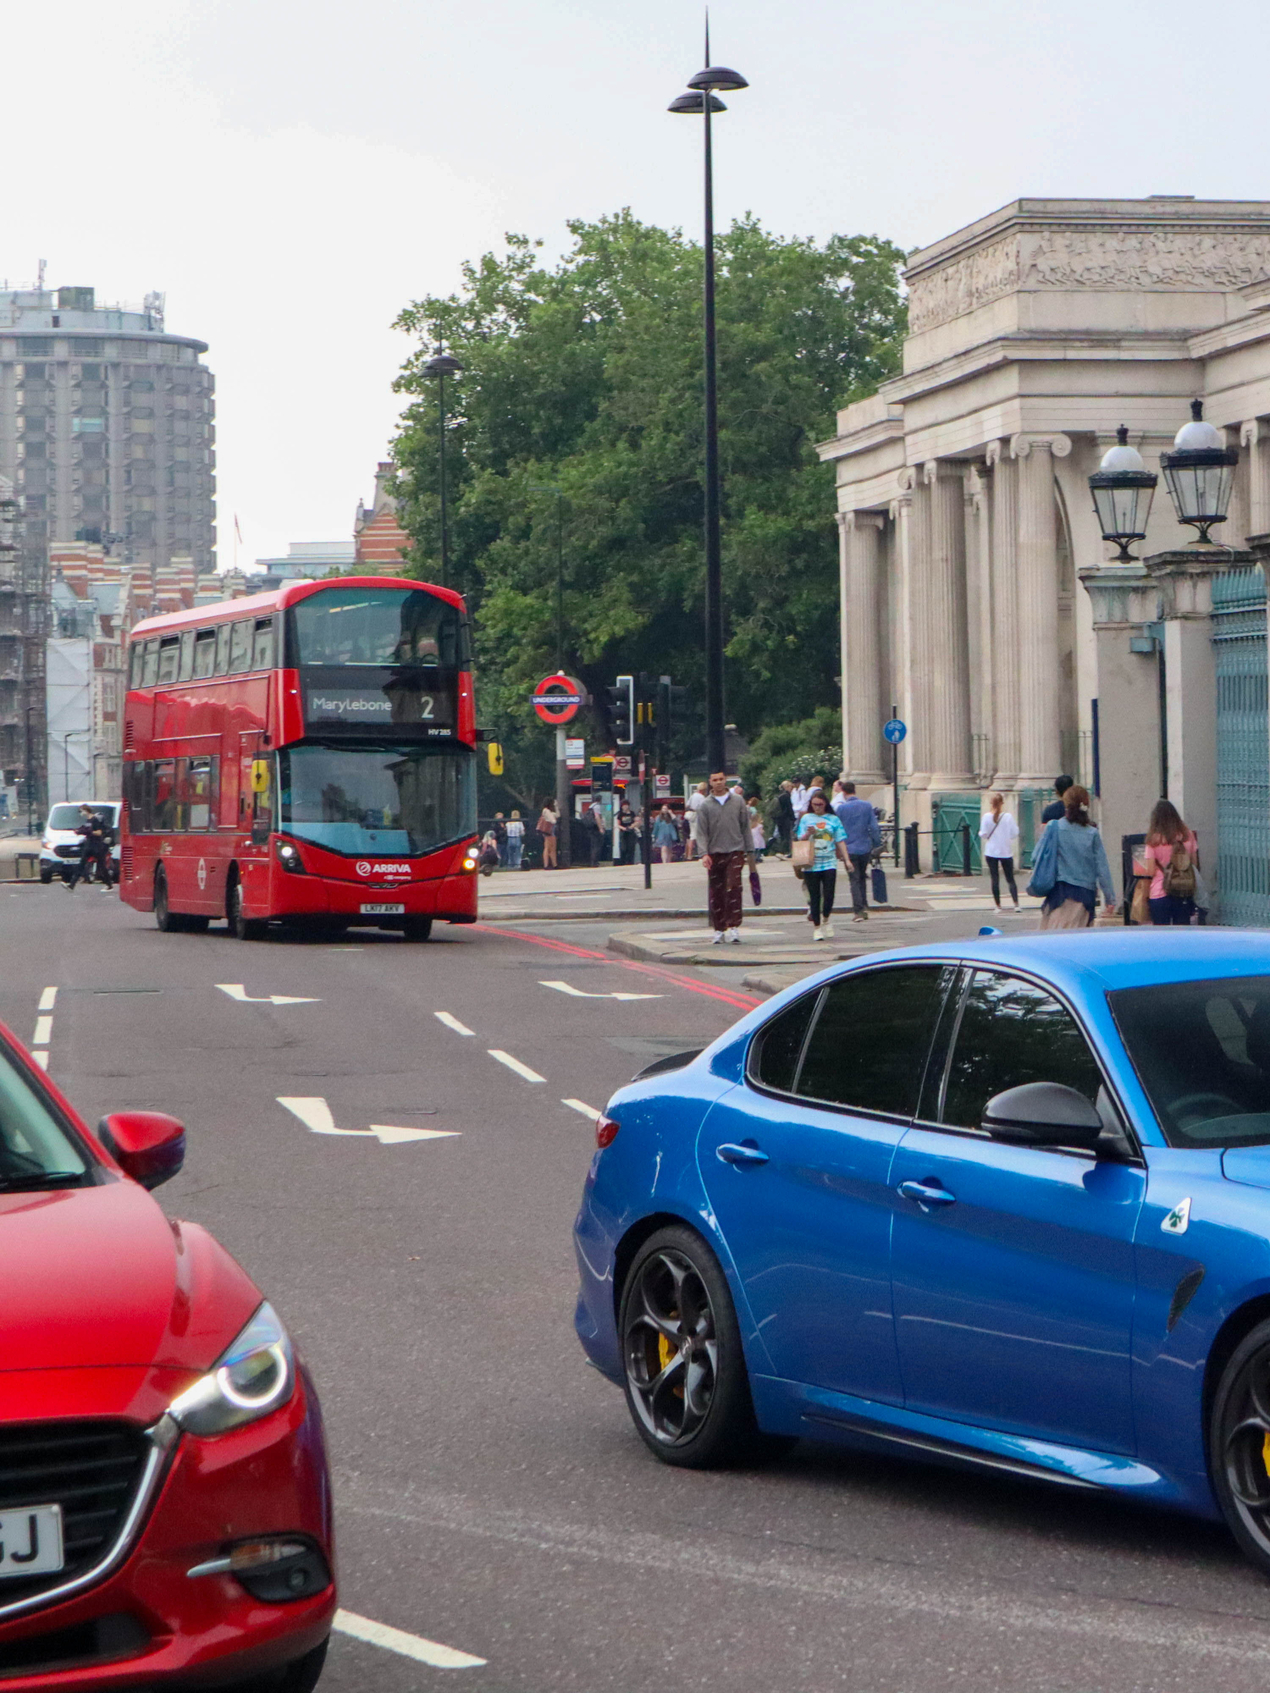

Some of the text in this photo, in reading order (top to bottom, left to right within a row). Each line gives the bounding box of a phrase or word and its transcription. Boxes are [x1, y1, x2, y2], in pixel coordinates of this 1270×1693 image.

[532, 695, 580, 703] UNDERGROUND
[312, 696, 435, 719] Marylebone 2
[372, 864, 412, 873] ARRIVA
